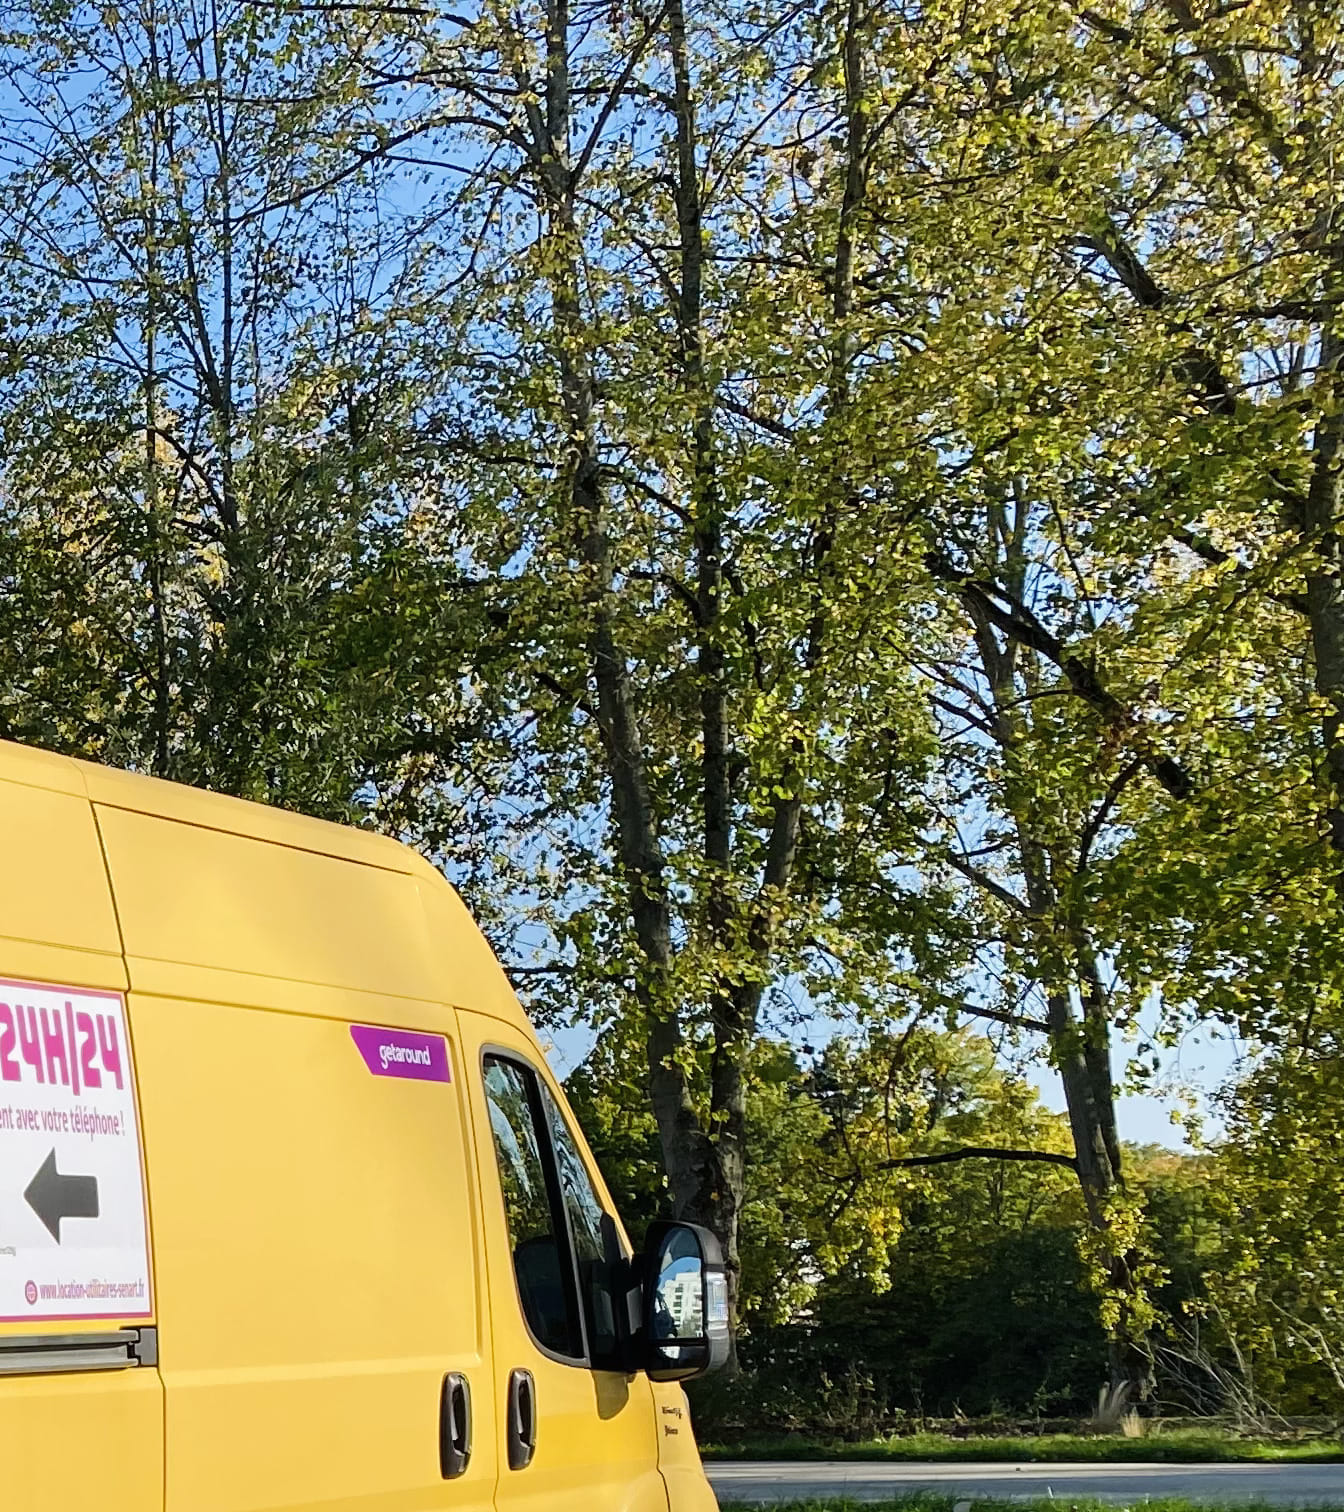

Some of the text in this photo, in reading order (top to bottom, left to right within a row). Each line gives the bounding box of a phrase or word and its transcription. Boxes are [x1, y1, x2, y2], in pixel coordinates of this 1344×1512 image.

[379, 1043, 432, 1069] getaround
[15, 1108, 41, 1132] avec
[41, 1107, 68, 1133] votre
